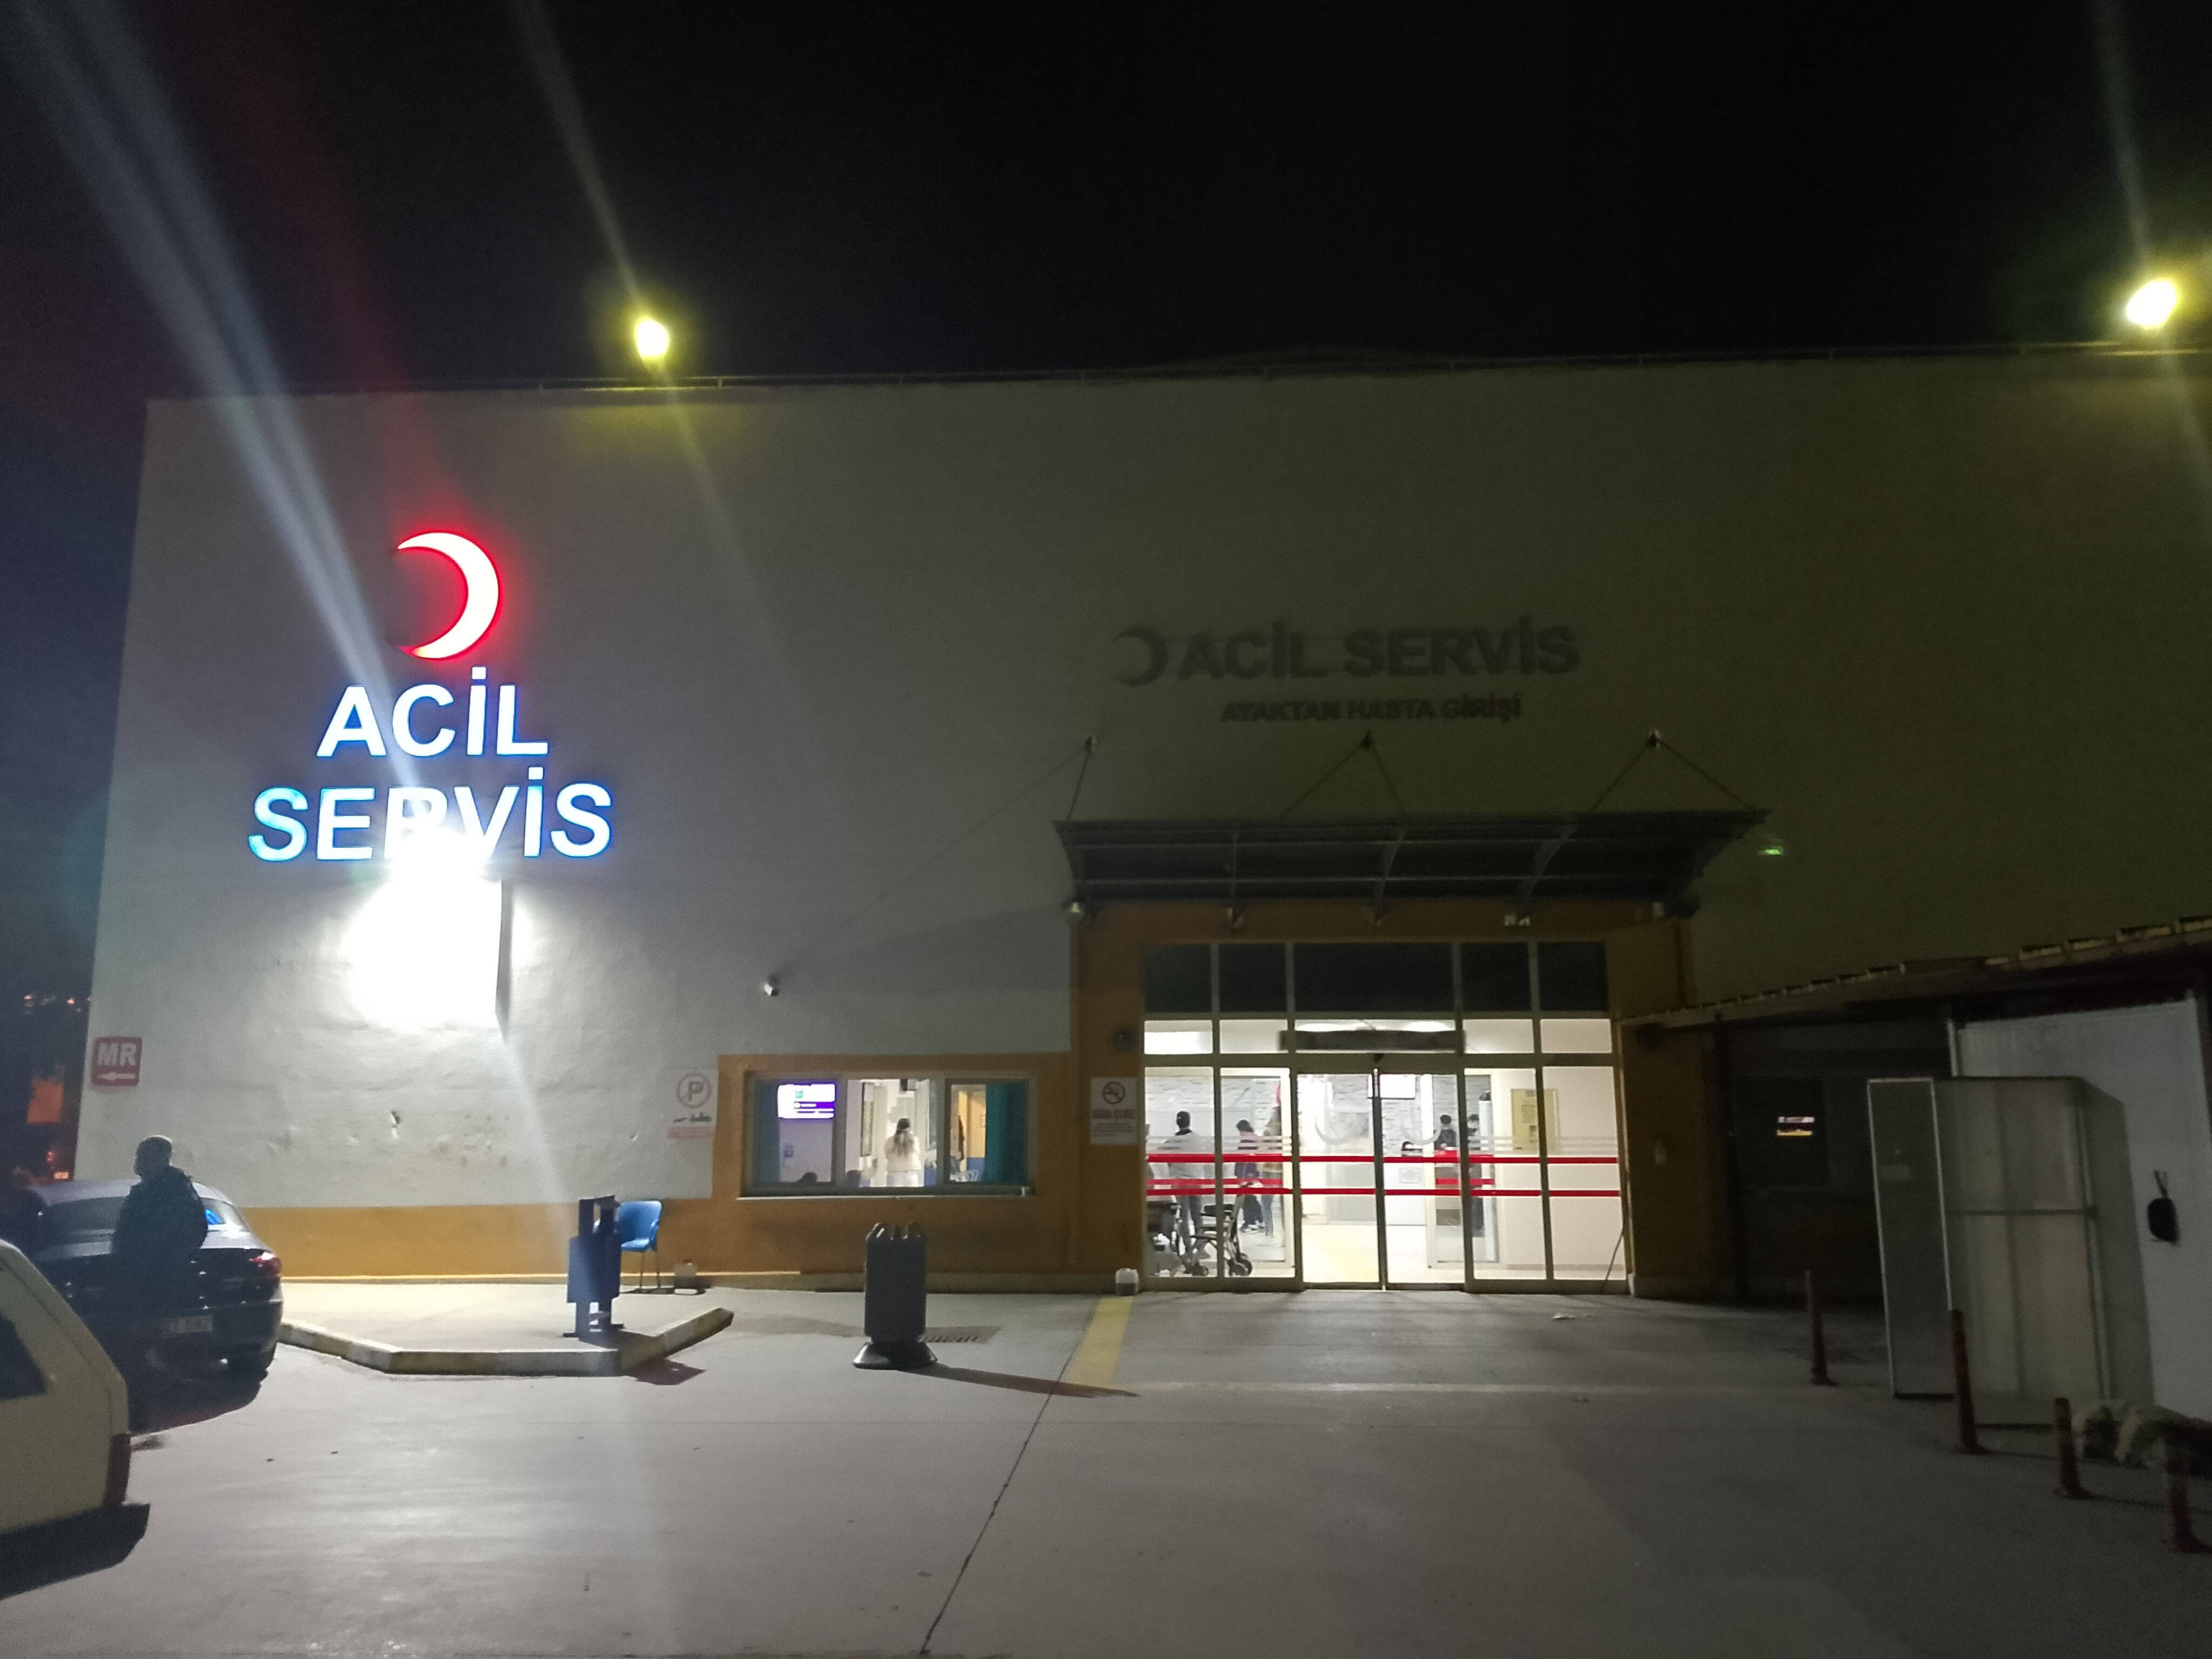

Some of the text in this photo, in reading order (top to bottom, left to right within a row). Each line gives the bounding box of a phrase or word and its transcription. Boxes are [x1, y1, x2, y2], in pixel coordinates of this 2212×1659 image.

[1178, 615, 1580, 680] ACİL SERVİS
[316, 666, 548, 757] ACİL
[1220, 700, 1340, 723] AYAKTAN
[1347, 699, 1435, 720] HASTA
[248, 767, 612, 861] SERVİS
[96, 1043, 137, 1067] MR
